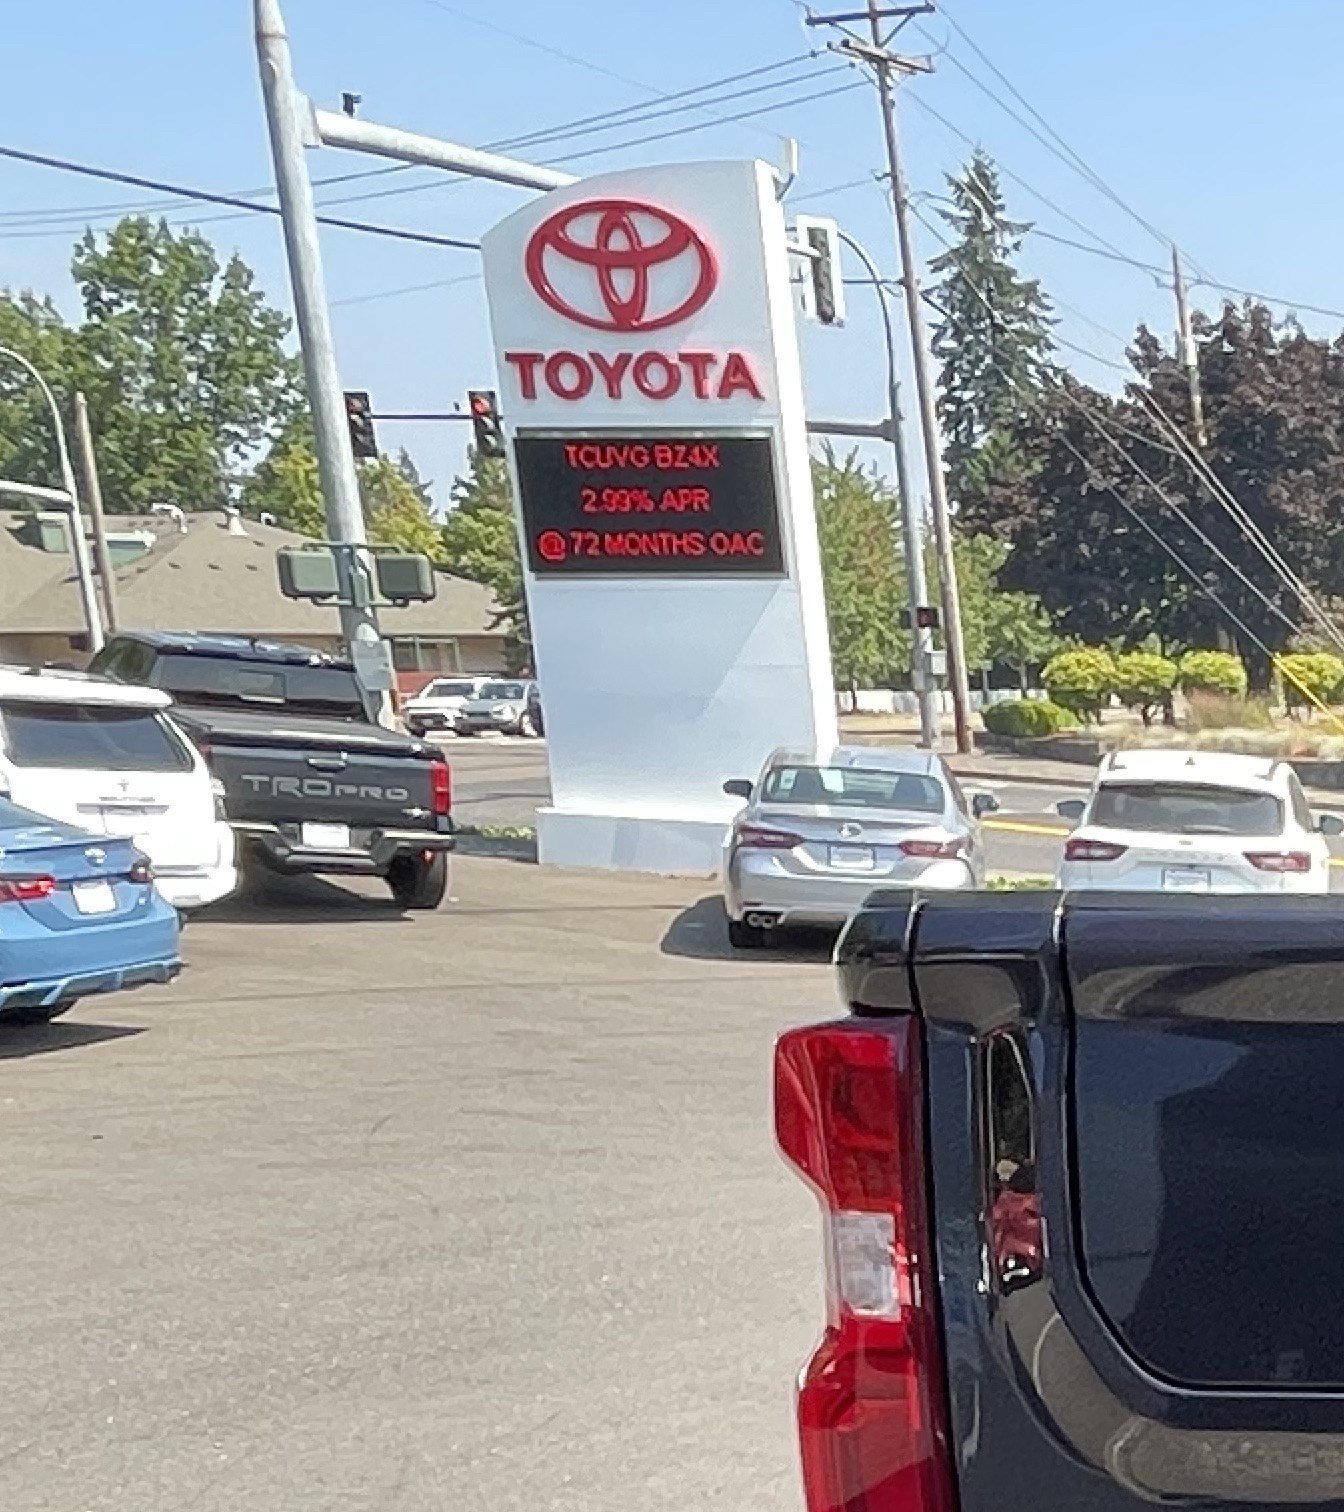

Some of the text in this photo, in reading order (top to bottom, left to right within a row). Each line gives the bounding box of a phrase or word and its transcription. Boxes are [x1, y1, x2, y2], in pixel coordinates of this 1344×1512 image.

[505, 351, 765, 400] TOYOTA
[659, 488, 711, 512] APR
[538, 530, 765, 560] @ 72 MONTHS OAC
